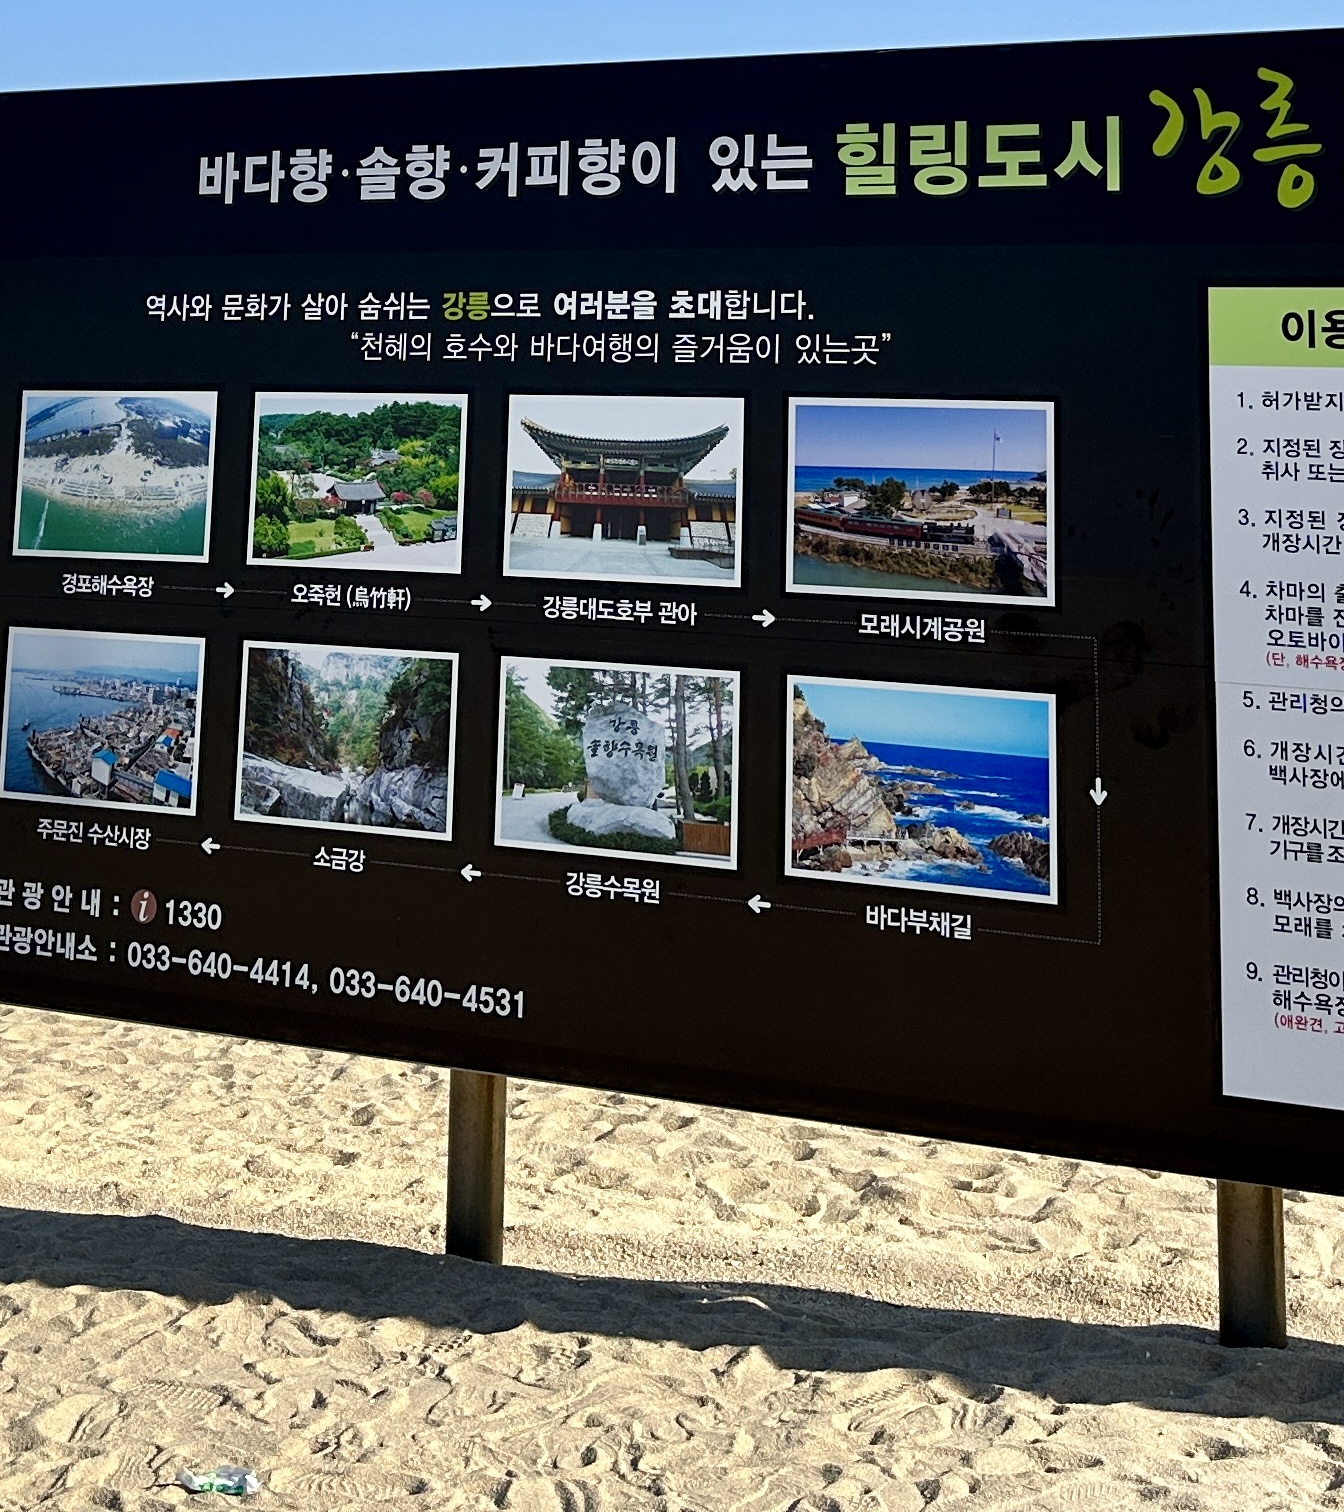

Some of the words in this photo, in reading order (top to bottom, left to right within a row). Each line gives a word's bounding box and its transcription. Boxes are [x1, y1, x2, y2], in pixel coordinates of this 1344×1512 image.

[708, 133, 814, 193] 있는
[835, 115, 1121, 196] 힐링도시
[145, 294, 213, 324] 역사와
[220, 293, 292, 323] 문화가
[301, 292, 348, 322] 살아
[358, 291, 431, 322] 숨쉬는
[441, 291, 542, 322] 강릉으로
[554, 289, 658, 322] 여러분을
[668, 289, 815, 322] 초대합니다.
[443, 332, 519, 363] 호수와
[530, 332, 660, 365] 바다여행의
[671, 332, 781, 366] 즐거움이
[1236, 392, 1253, 410] 1.
[1261, 391, 1344, 413] 허가받지
[61, 572, 155, 599] 경포해수욕장
[291, 582, 342, 608] 오죽헌
[543, 595, 654, 624] 강릉대도호부
[659, 599, 697, 627] 관아
[858, 613, 986, 644] 모래시계공원
[1242, 690, 1261, 710] 5.
[36, 817, 85, 844] 주문진
[87, 820, 152, 851] 수산시장
[312, 846, 366, 874] 소금강
[566, 872, 661, 904] 강릉수목원
[165, 898, 223, 931] 1330
[866, 904, 973, 942] 바다부채길
[127, 941, 319, 995] 033-640-4414,
[329, 966, 526, 1020] 033-640-4531
